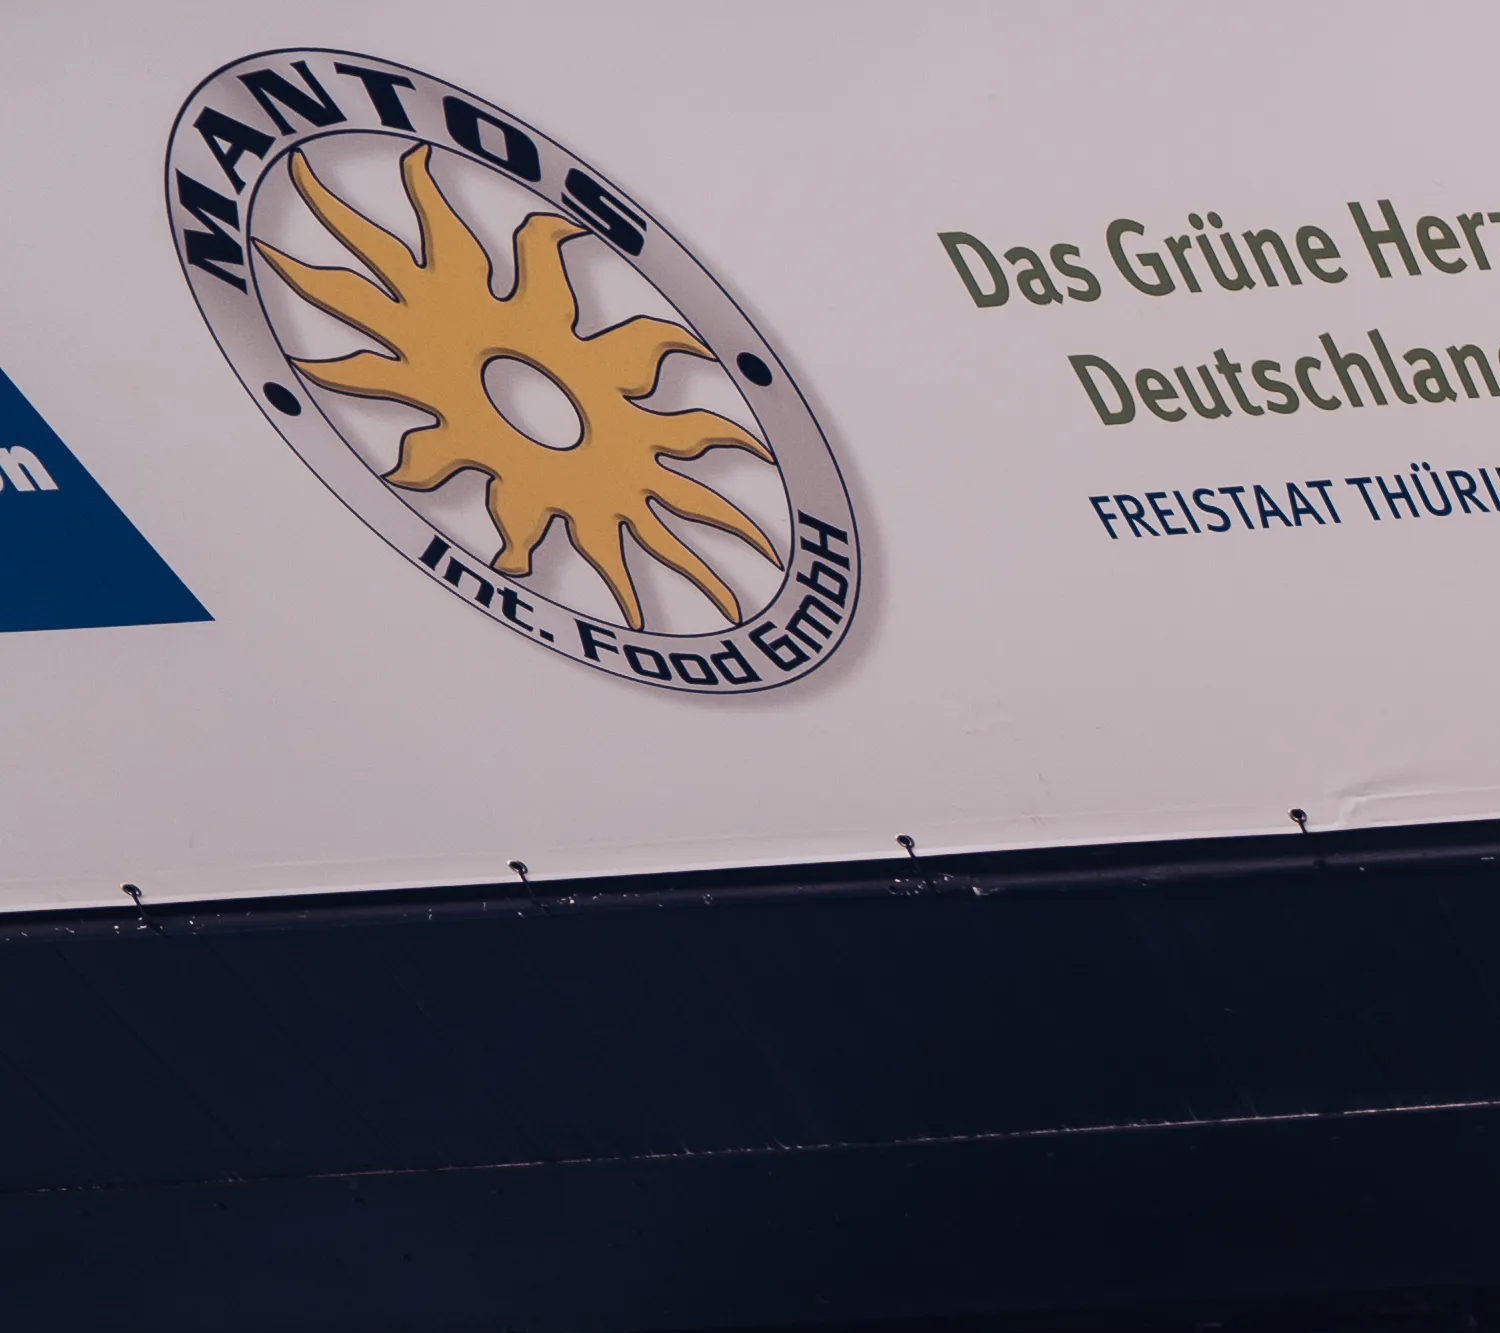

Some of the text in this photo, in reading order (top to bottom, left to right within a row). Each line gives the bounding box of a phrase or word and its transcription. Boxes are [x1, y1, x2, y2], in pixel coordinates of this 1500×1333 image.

[175, 60, 648, 294] MANTOS
[938, 228, 1102, 308] Das
[1105, 210, 1348, 302] Grüne
[1087, 477, 1342, 540] FREISTAAT
[418, 509, 850, 686] Int. Food GmbH
